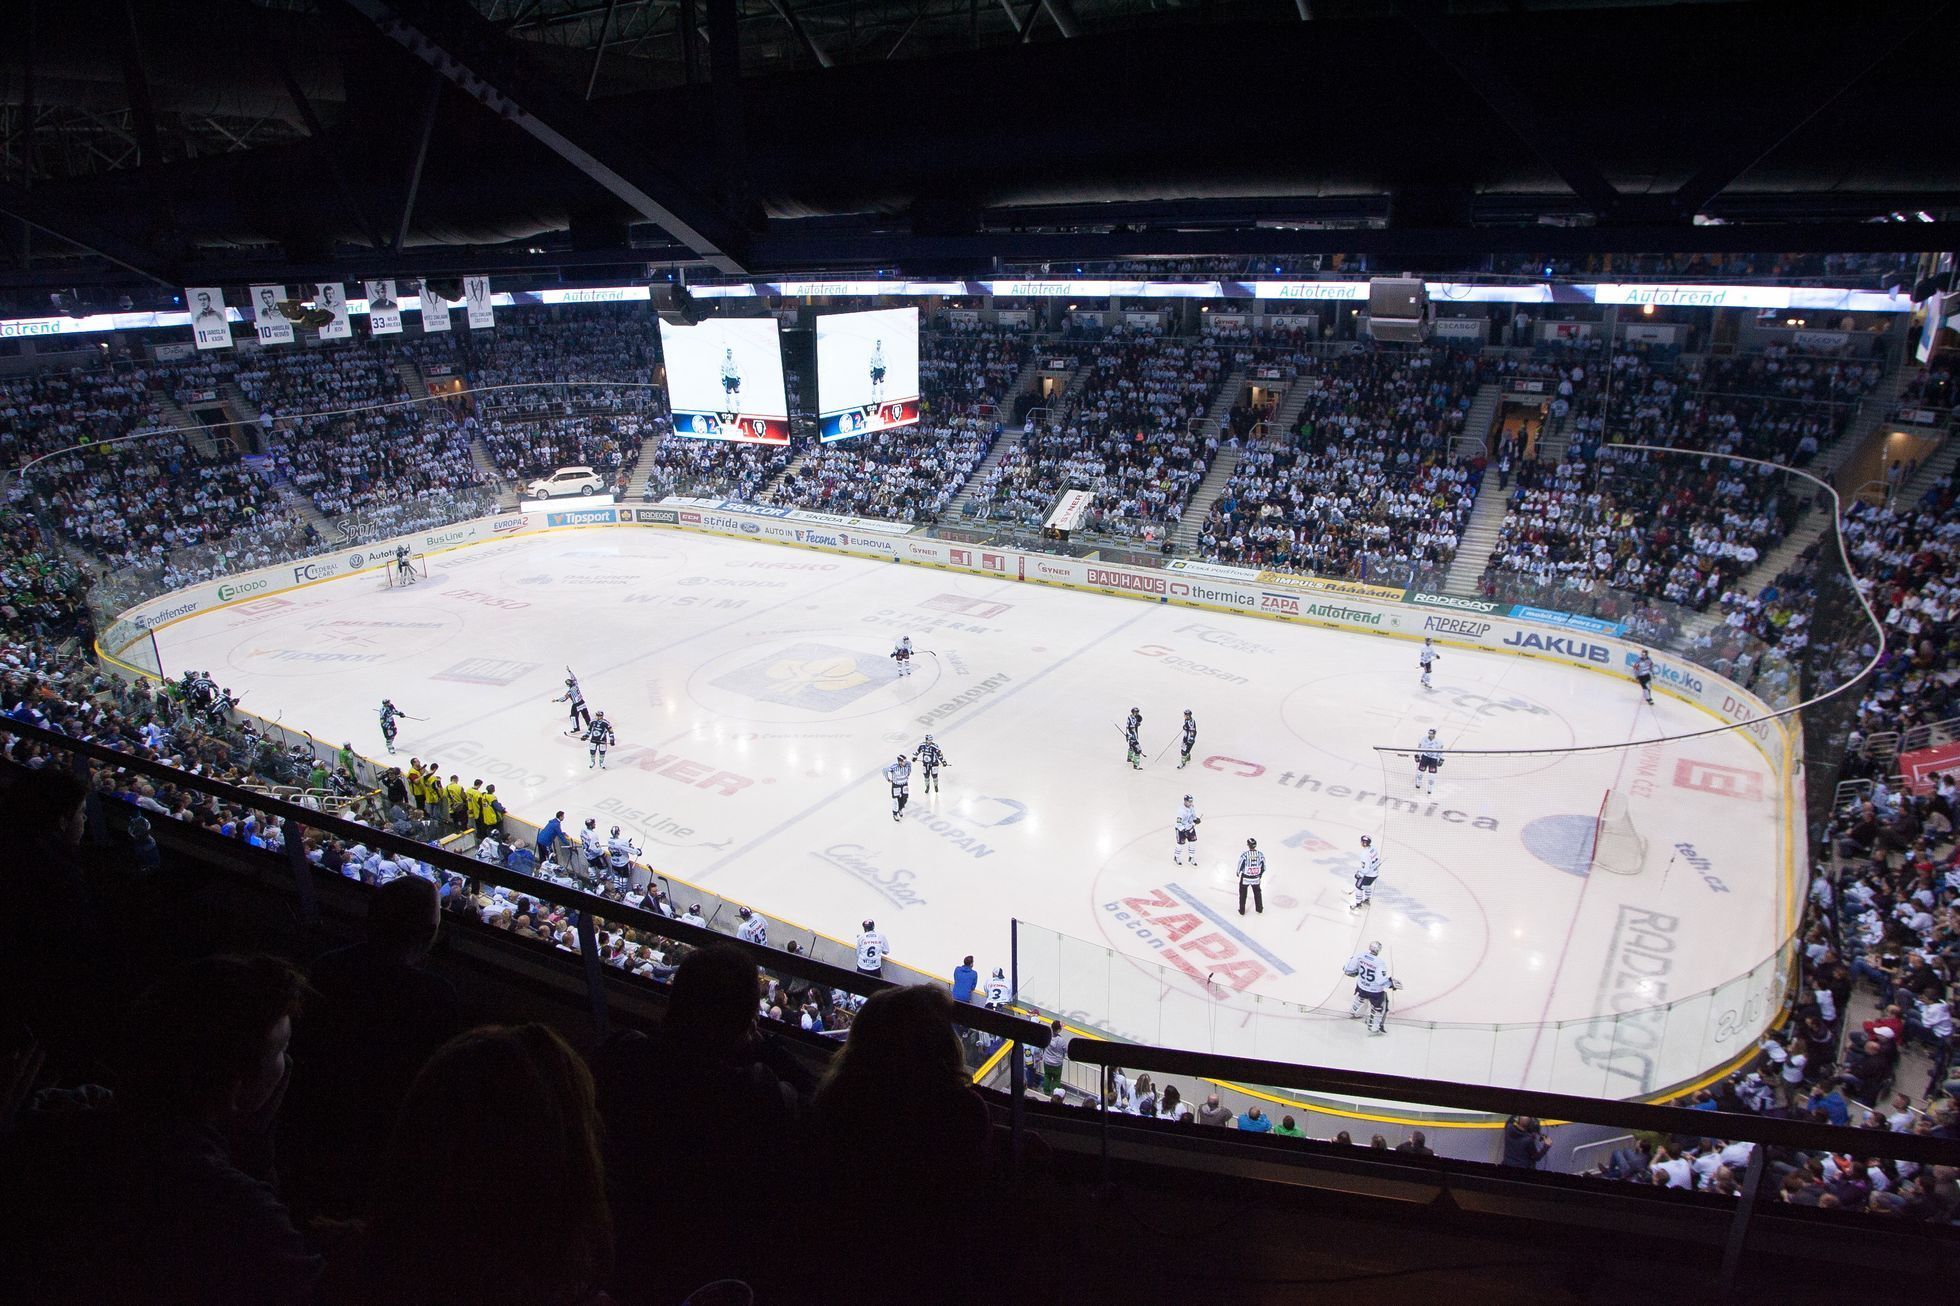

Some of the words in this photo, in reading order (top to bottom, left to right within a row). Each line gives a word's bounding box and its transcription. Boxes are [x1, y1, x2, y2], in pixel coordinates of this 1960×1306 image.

[563, 288, 624, 302] Autotrend
[797, 282, 848, 296] Autotrend
[1011, 282, 1071, 296] Autotrend
[1279, 283, 1357, 299] Autotrend
[1625, 286, 1727, 306] Autotrend
[372, 317, 386, 329] 33
[198, 330, 208, 342] 11
[259, 326, 272, 339] 10
[566, 511, 610, 524] Tipsport
[640, 511, 675, 522] RADEGAST
[723, 502, 785, 517] SENCOR
[494, 518, 522, 530] EVROPA
[522, 516, 529, 527] 2
[703, 516, 738, 529] střída
[336, 518, 380, 544] Sport
[427, 536, 445, 546] Bus
[446, 530, 463, 542] Line
[765, 527, 785, 537] AUTO
[785, 529, 794, 538] IN
[805, 530, 837, 546] Ferona
[850, 537, 892, 550] EUROVIA
[369, 543, 411, 562] Autotrd
[912, 547, 938, 557] SYNER
[294, 563, 318, 585] FC
[312, 563, 338, 576] FEDERAL
[318, 570, 335, 580] CARS
[1041, 566, 1071, 577] SYNER
[1088, 571, 1166, 593] BAUHAUS
[1275, 576, 1324, 589] IMPULS
[441, 589, 531, 609] DENSO
[1192, 585, 1255, 607] thermica
[1261, 596, 1300, 611] ZAPA
[1413, 593, 1498, 612] RADEGAST
[147, 601, 198, 628] Profifenster
[1260, 606, 1281, 614] beton
[1306, 603, 1382, 625] Autotrend
[1173, 623, 1225, 645] FC
[1503, 631, 1610, 664] JAKUB
[1161, 653, 1250, 688] geosan
[1651, 663, 1703, 693] okejka
[1722, 695, 1770, 741] DENSO
[1277, 770, 1500, 833] thermica
[593, 797, 641, 821] Bus
[642, 807, 696, 839] Line
[1674, 841, 1730, 895] telh.cz
[1102, 901, 1165, 951] beton
[1121, 888, 1268, 996] ZAPA
[866, 946, 876, 958] 6
[1358, 965, 1376, 982] 25
[992, 988, 1002, 1000] 3
[1574, 905, 1681, 1096] RADEGAST
